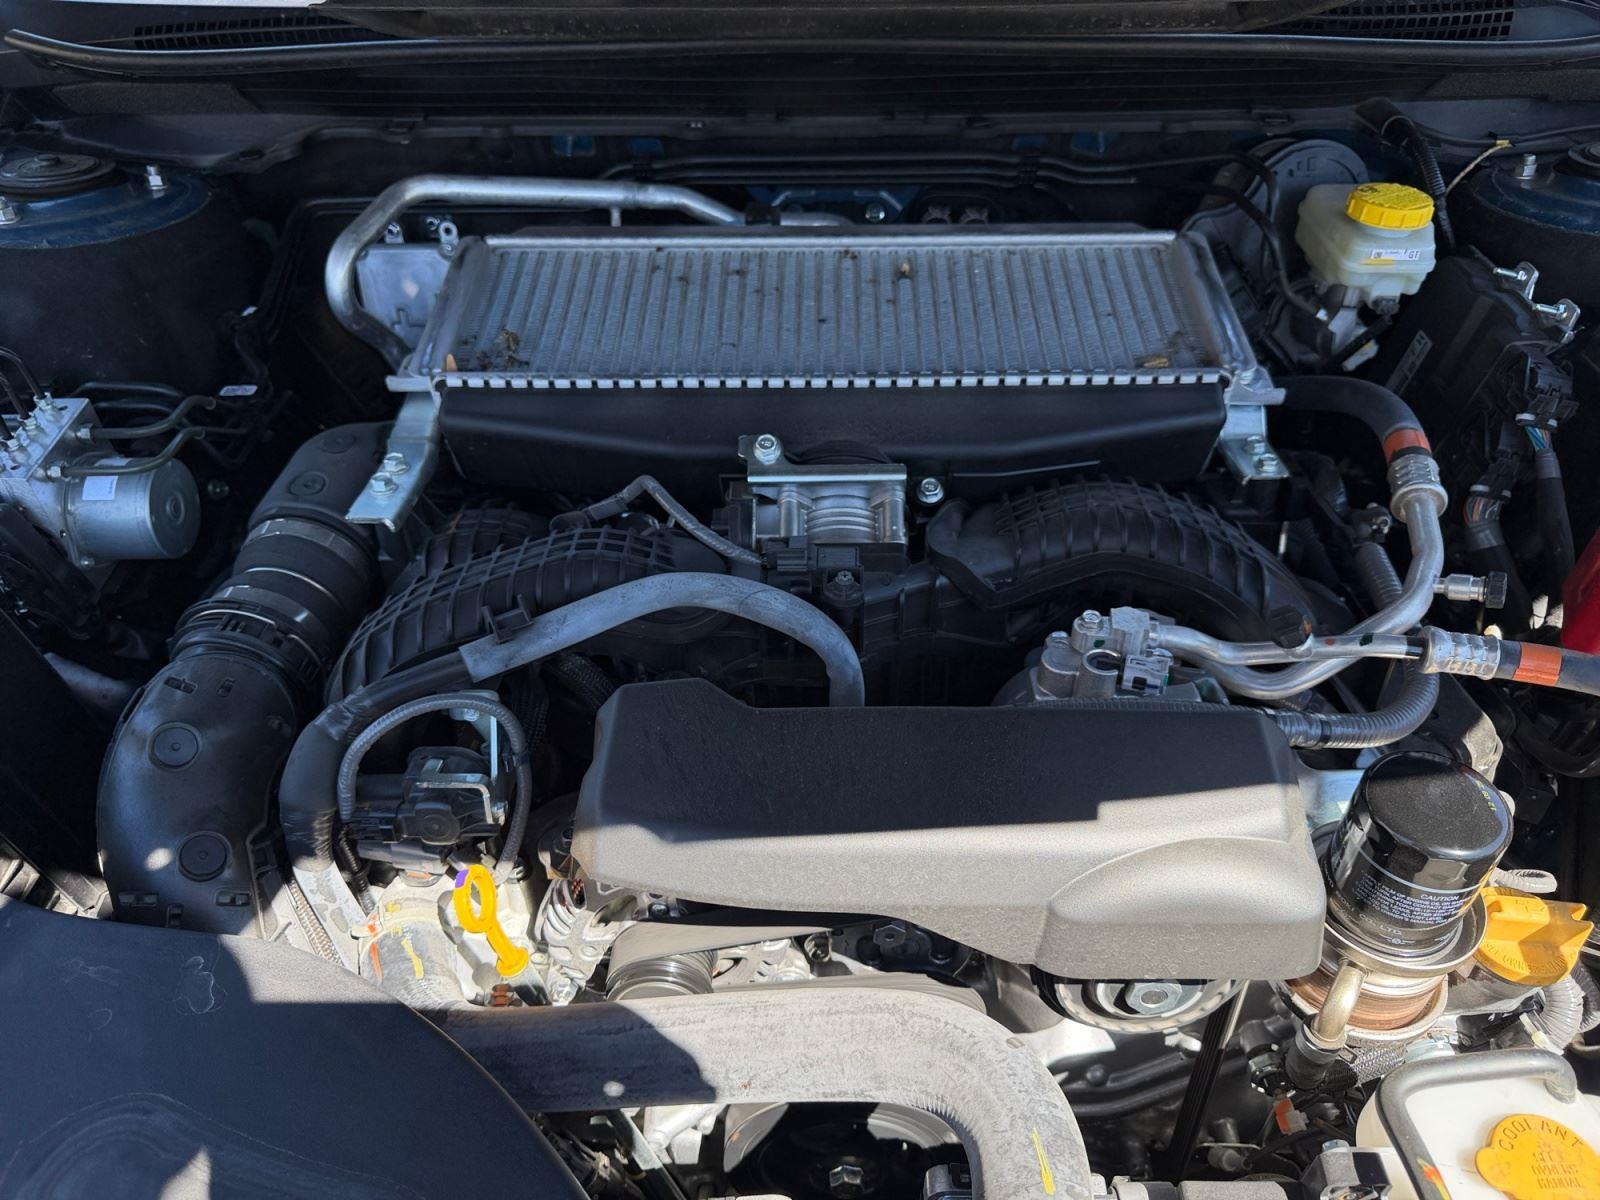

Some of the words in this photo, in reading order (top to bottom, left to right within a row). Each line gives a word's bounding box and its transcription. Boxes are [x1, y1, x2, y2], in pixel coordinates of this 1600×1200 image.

[1392, 895, 1412, 905] AFTER
[1412, 902, 1442, 910] CONTACT
[1406, 896, 1431, 905] ENGINE
[1420, 893, 1460, 902] CAUTION
[1498, 1118, 1584, 1152] COOLANT
